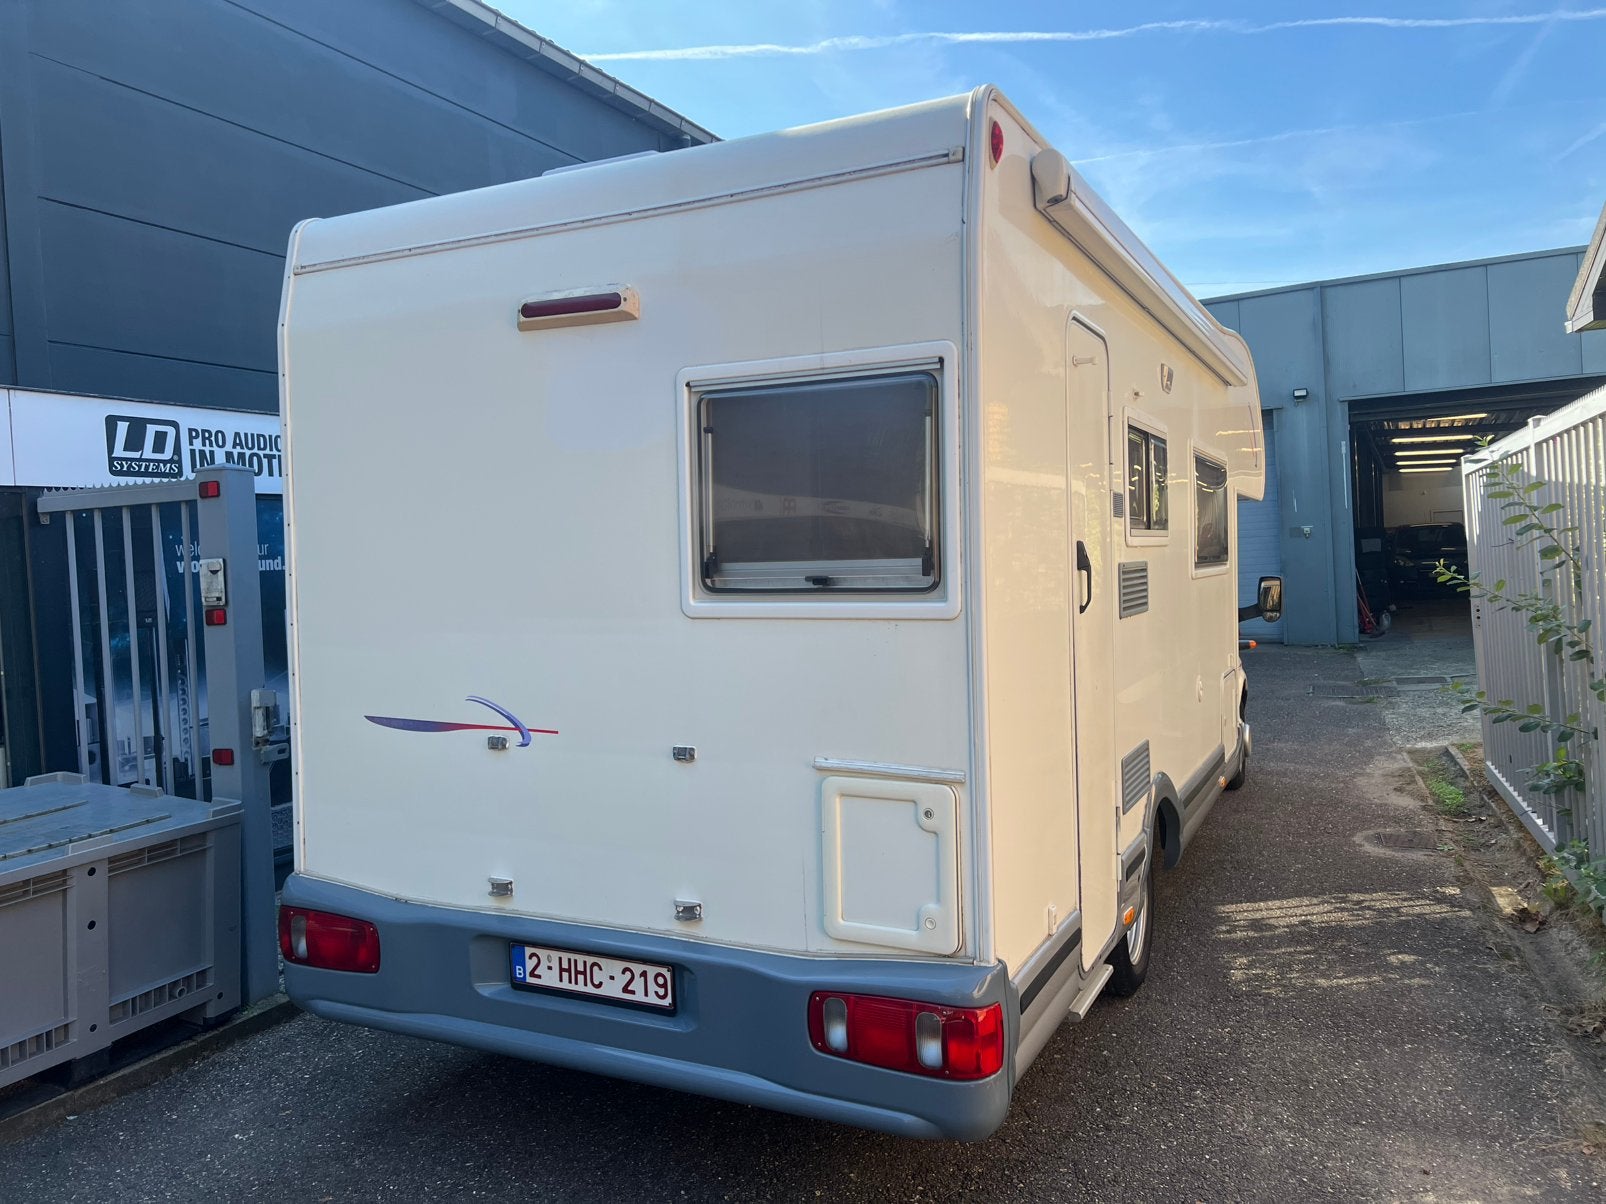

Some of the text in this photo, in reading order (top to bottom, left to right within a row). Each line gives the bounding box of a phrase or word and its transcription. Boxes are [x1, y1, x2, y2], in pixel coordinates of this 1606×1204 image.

[111, 420, 177, 460] LD
[188, 427, 227, 449] PRO
[112, 460, 179, 474] SYSTEMS
[225, 451, 282, 477] MOTI
[516, 966, 524, 978] B
